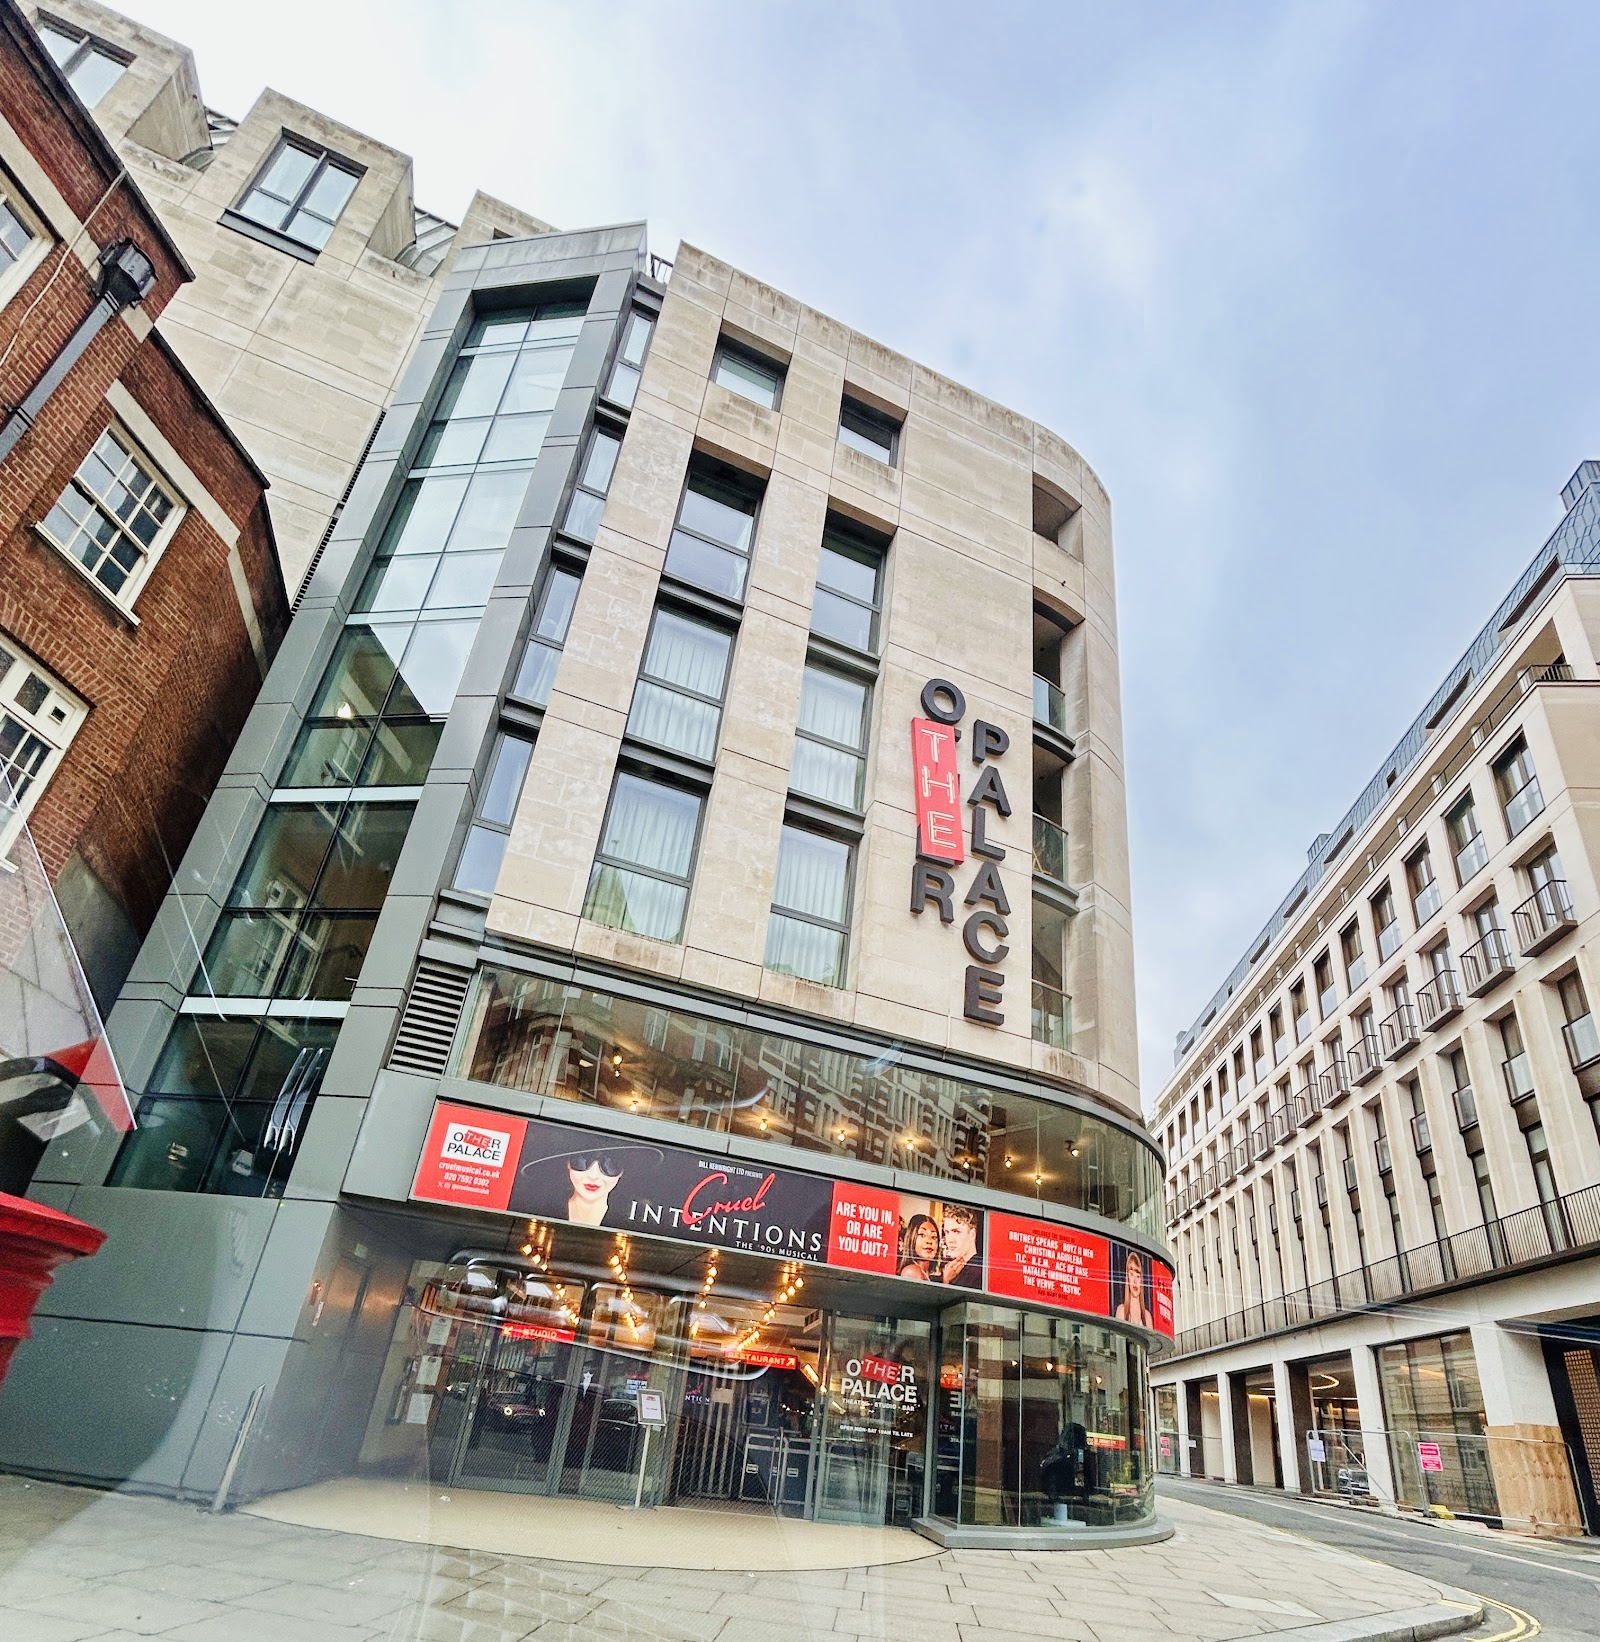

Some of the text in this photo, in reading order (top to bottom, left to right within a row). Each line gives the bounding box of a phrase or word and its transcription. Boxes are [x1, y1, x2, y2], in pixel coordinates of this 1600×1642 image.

[910, 678, 966, 924] OTHER
[963, 719, 1012, 1026] PALACE
[453, 1130, 502, 1149] OTHER
[447, 1142, 502, 1161] PALACE
[439, 1162, 500, 1178] cruelmusical.co.uk
[444, 1172, 457, 1182] 020
[457, 1174, 473, 1184] 7592
[698, 1160, 709, 1169] BILL
[736, 1167, 745, 1176] LTD
[745, 1170, 764, 1179] PRESENTS
[682, 1172, 775, 1225] Cruel
[835, 1201, 895, 1227] ARE YOU IN,
[628, 1200, 822, 1252] INTENTIONS
[846, 1220, 883, 1240] OR ARE
[735, 1240, 753, 1250] THE
[779, 1248, 818, 1261] MUSICAL
[838, 1235, 889, 1258] YOU OUT?
[1009, 1231, 1035, 1245] BRITNEY
[1035, 1236, 1058, 1250] SPEARS
[1063, 1243, 1077, 1254] BOYZ
[1083, 1248, 1094, 1259] MEN
[1024, 1244, 1083, 1265] CHRISTINA AGUILERA
[1015, 1253, 1027, 1263] TLC
[1055, 1262, 1067, 1271] ACE
[1067, 1264, 1075, 1273] OF
[1075, 1266, 1089, 1277] BASE
[1022, 1265, 1079, 1285] NATALIE IMBRUGLIA
[1023, 1276, 1035, 1286] THE
[1036, 1278, 1055, 1290] VERVE
[523, 1326, 557, 1339] STUDIO
[728, 1352, 786, 1365] RESTAURANT
[846, 1357, 915, 1383] OTHER
[840, 1378, 918, 1403] PALACE
[874, 1402, 897, 1410] STUDIO
